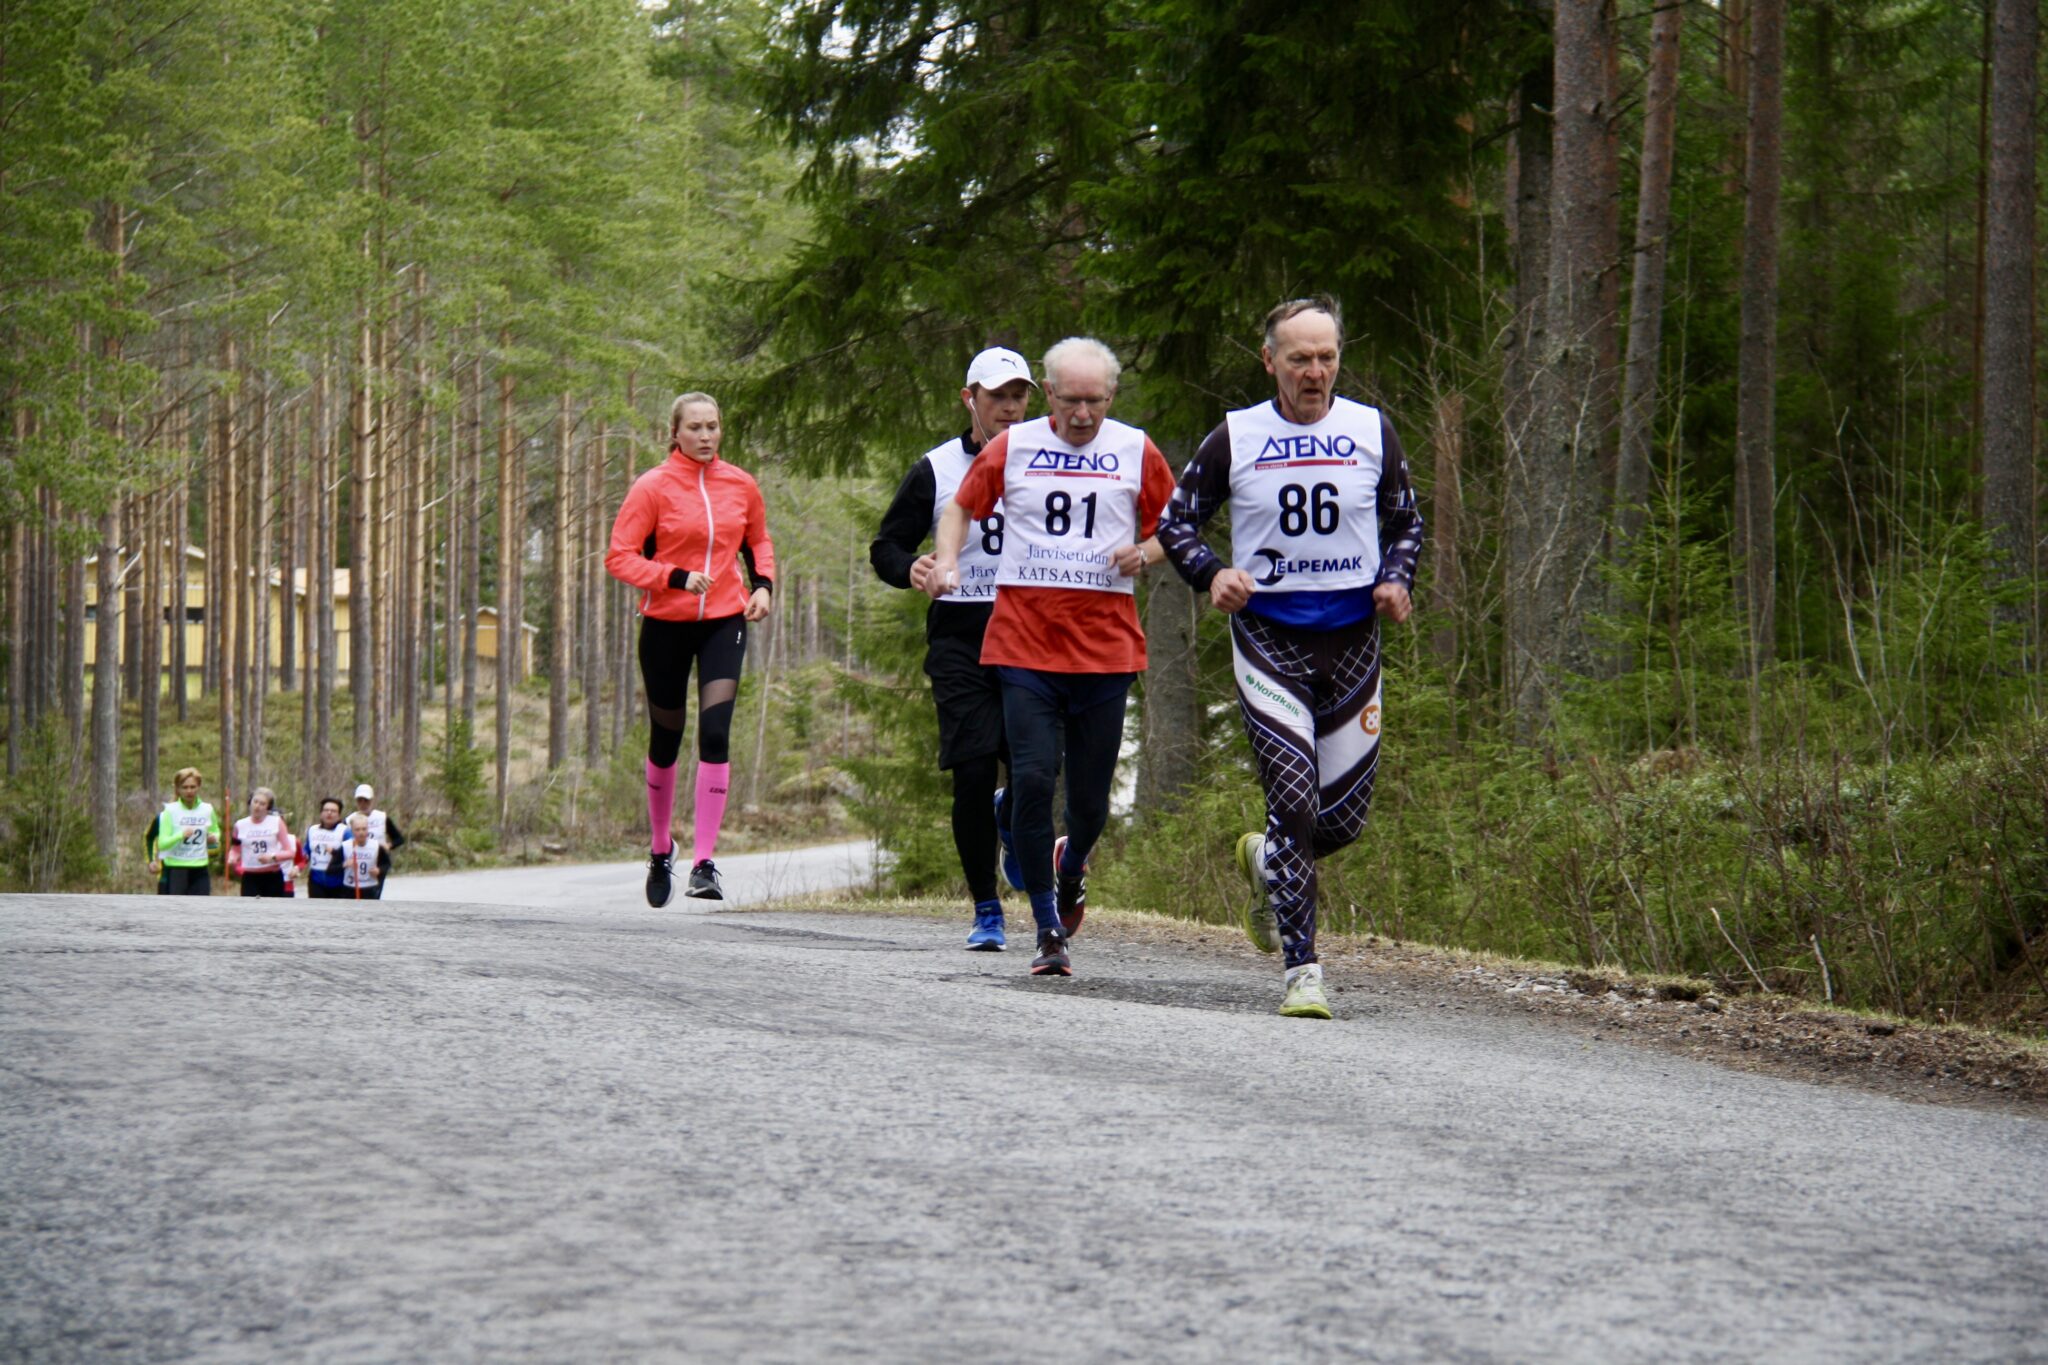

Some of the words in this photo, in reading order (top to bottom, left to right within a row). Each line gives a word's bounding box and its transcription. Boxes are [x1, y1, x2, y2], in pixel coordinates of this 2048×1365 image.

[1027, 448, 1119, 472] ATENO
[1256, 435, 1356, 462] ATENO
[1045, 490, 1097, 539] 81
[1278, 482, 1340, 537] 86
[1026, 544, 1109, 566] Järviseudun
[1276, 556, 1362, 574] ELPEMAK
[1018, 566, 1112, 588] KATSASTUS
[1253, 680, 1301, 718] Nordkalk
[252, 841, 267, 854] 39
